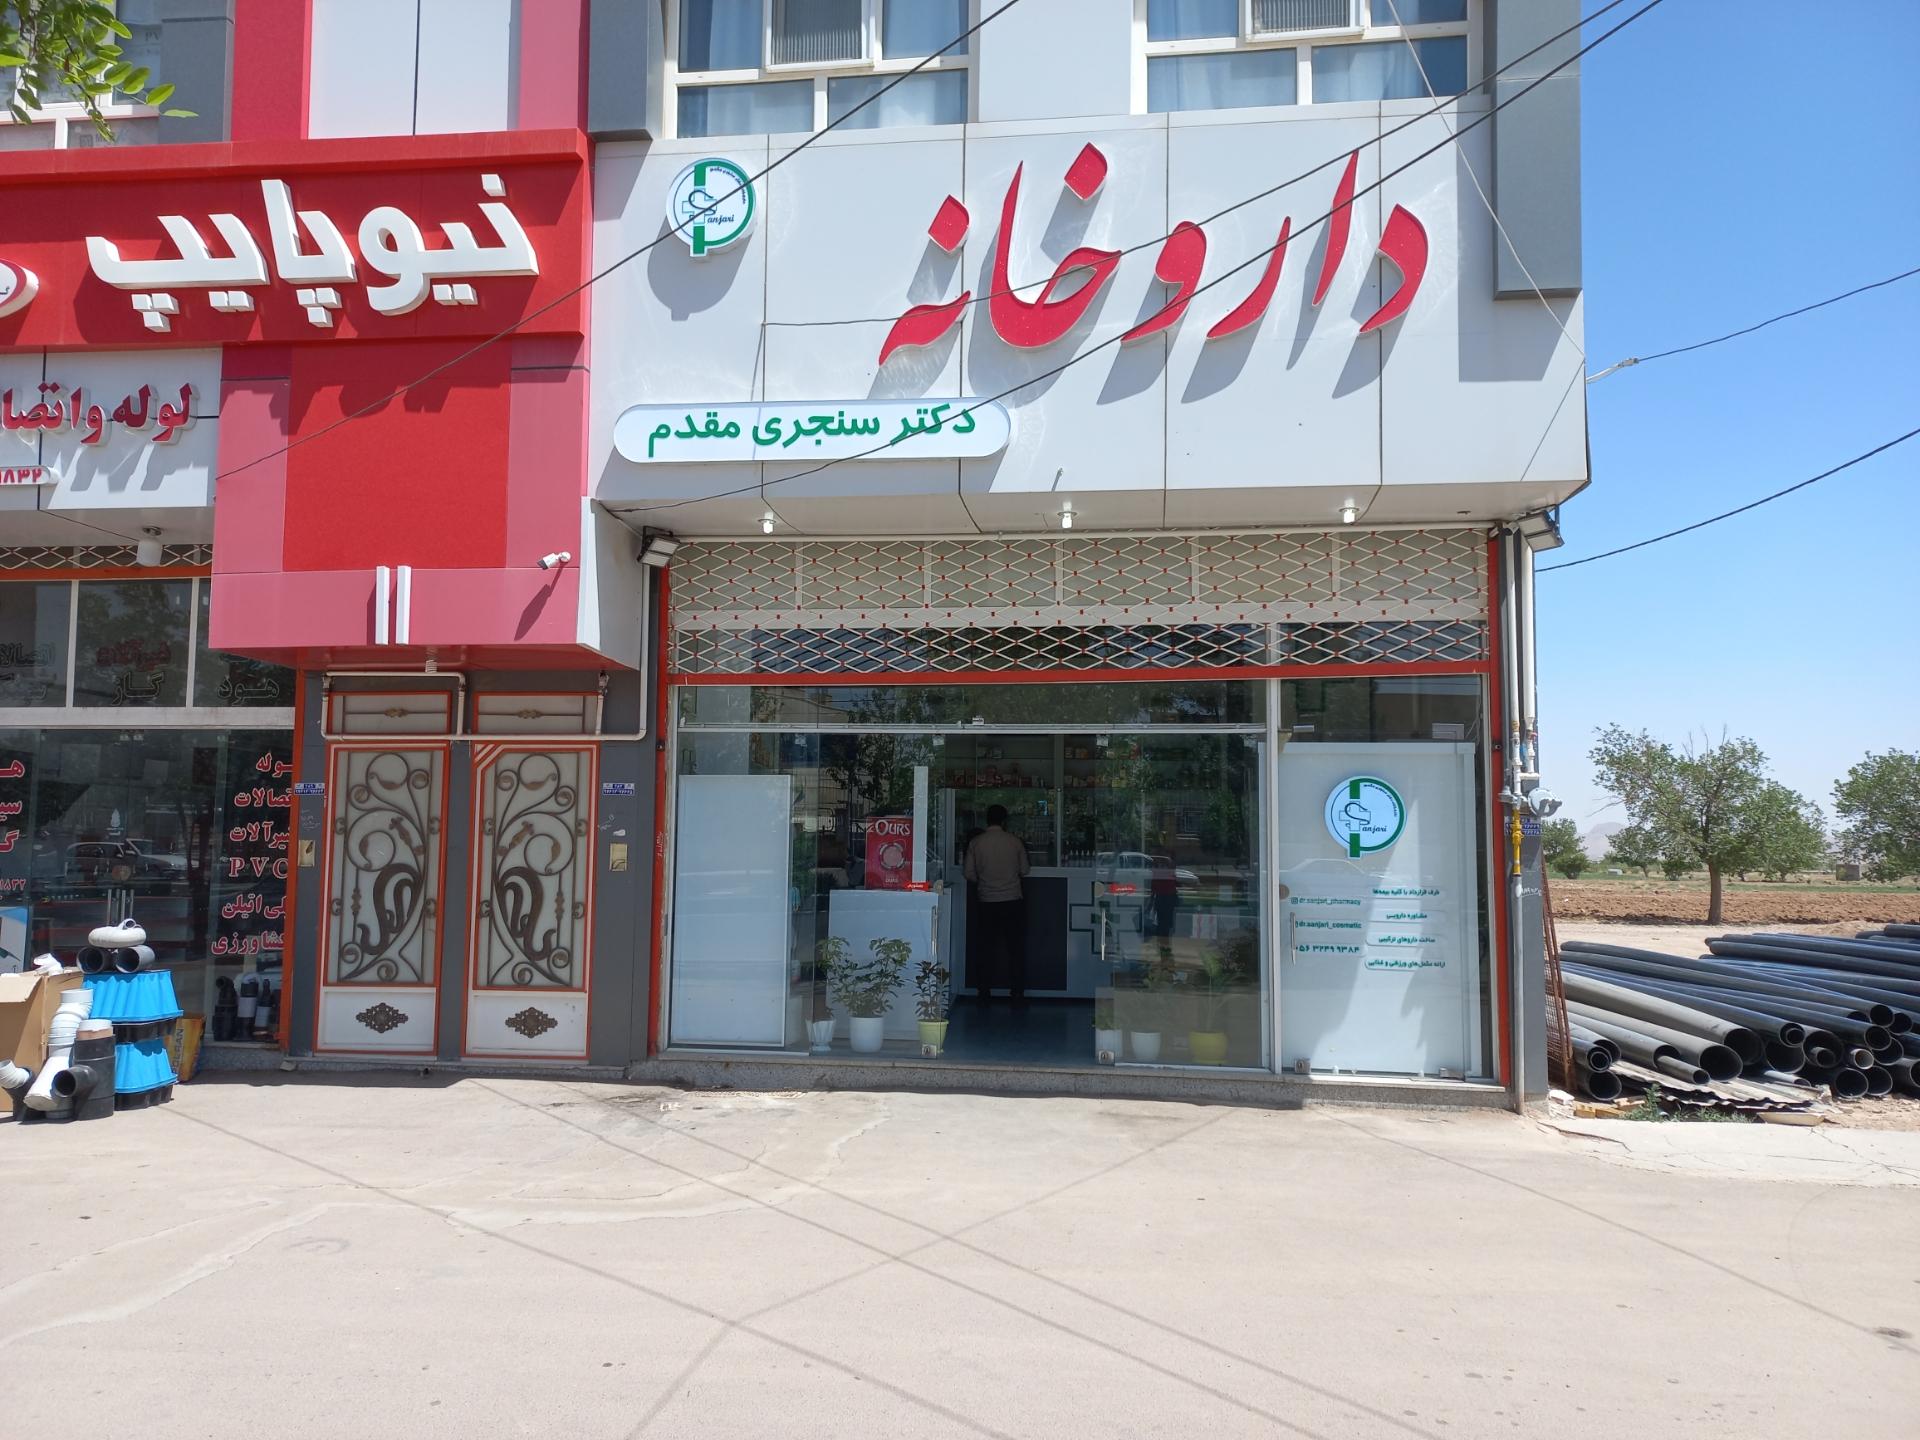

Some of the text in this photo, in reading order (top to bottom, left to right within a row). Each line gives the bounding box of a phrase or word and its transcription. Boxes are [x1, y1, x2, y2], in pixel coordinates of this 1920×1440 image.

[879, 141, 1429, 367] داروخانه
[112, 382, 197, 442] لوله
[648, 403, 976, 458] دکتر سنجری مقدم
[256, 752, 294, 778] وله
[222, 893, 263, 918] اتیلن
